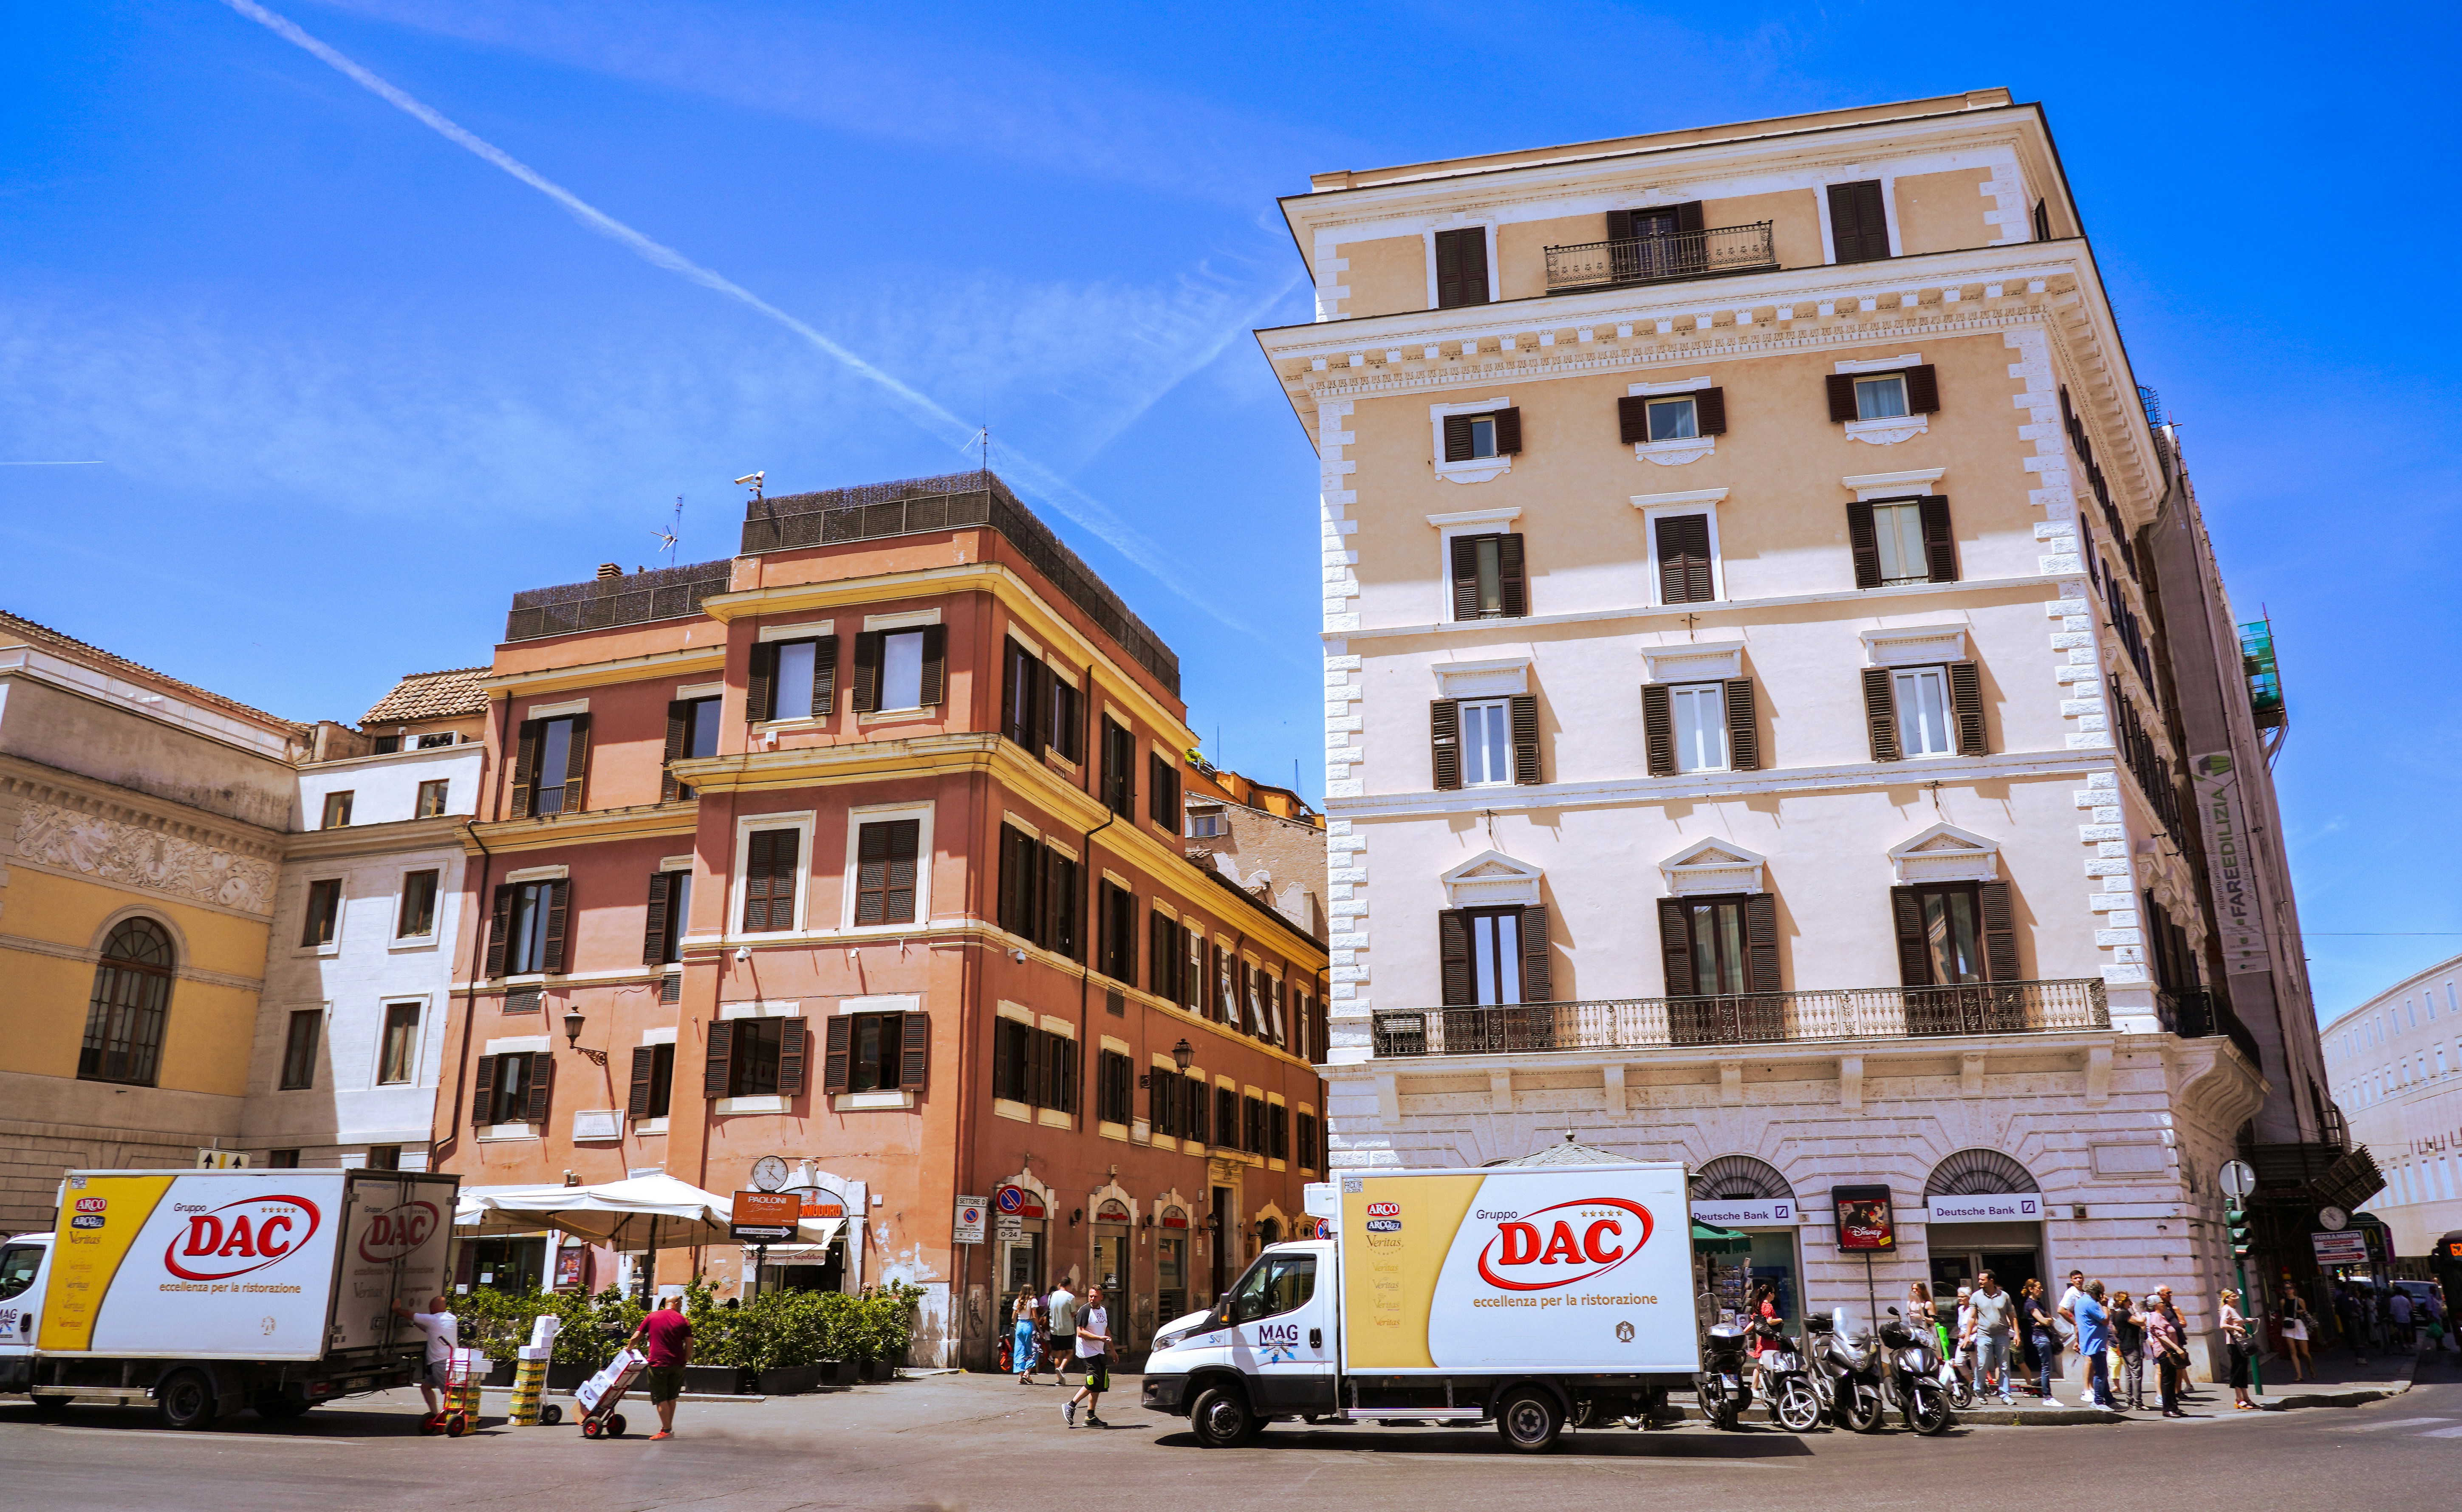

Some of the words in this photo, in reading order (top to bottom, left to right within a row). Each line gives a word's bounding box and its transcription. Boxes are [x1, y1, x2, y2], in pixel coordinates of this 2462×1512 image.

[2211, 787, 2247, 917] FAREEDILIZIA
[2210, 860, 2226, 910] Ristrutturazioni
[76, 1199, 106, 1210] ARCO
[748, 1196, 787, 1204] PAOLONI
[174, 1203, 207, 1213] Gruppo
[1368, 1204, 1399, 1216] ARCO
[1937, 1207, 1985, 1216] Deutsche
[1989, 1206, 2015, 1215] Bank
[1476, 1210, 1518, 1221] Gruppo
[1694, 1212, 1741, 1221] Deutsche
[1744, 1211, 1769, 1220] Bank
[183, 1215, 292, 1258] DAC
[369, 1215, 427, 1246] DAC
[1849, 1226, 1883, 1238] Disney
[68, 1231, 102, 1244] Veritas
[1365, 1235, 1402, 1247] Veritas
[1498, 1219, 1623, 1265] DAC
[159, 1281, 209, 1292] eccellenza
[210, 1283, 229, 1295] per
[231, 1282, 239, 1292] la
[242, 1282, 301, 1293] ristorazione
[1473, 1295, 1537, 1307] eccellenza
[1541, 1297, 1562, 1309] per
[1566, 1294, 1577, 1306] la
[1581, 1292, 1658, 1305] ristorazione
[1373, 1316, 1400, 1326] Veritas
[1259, 1324, 1298, 1341] MAG
